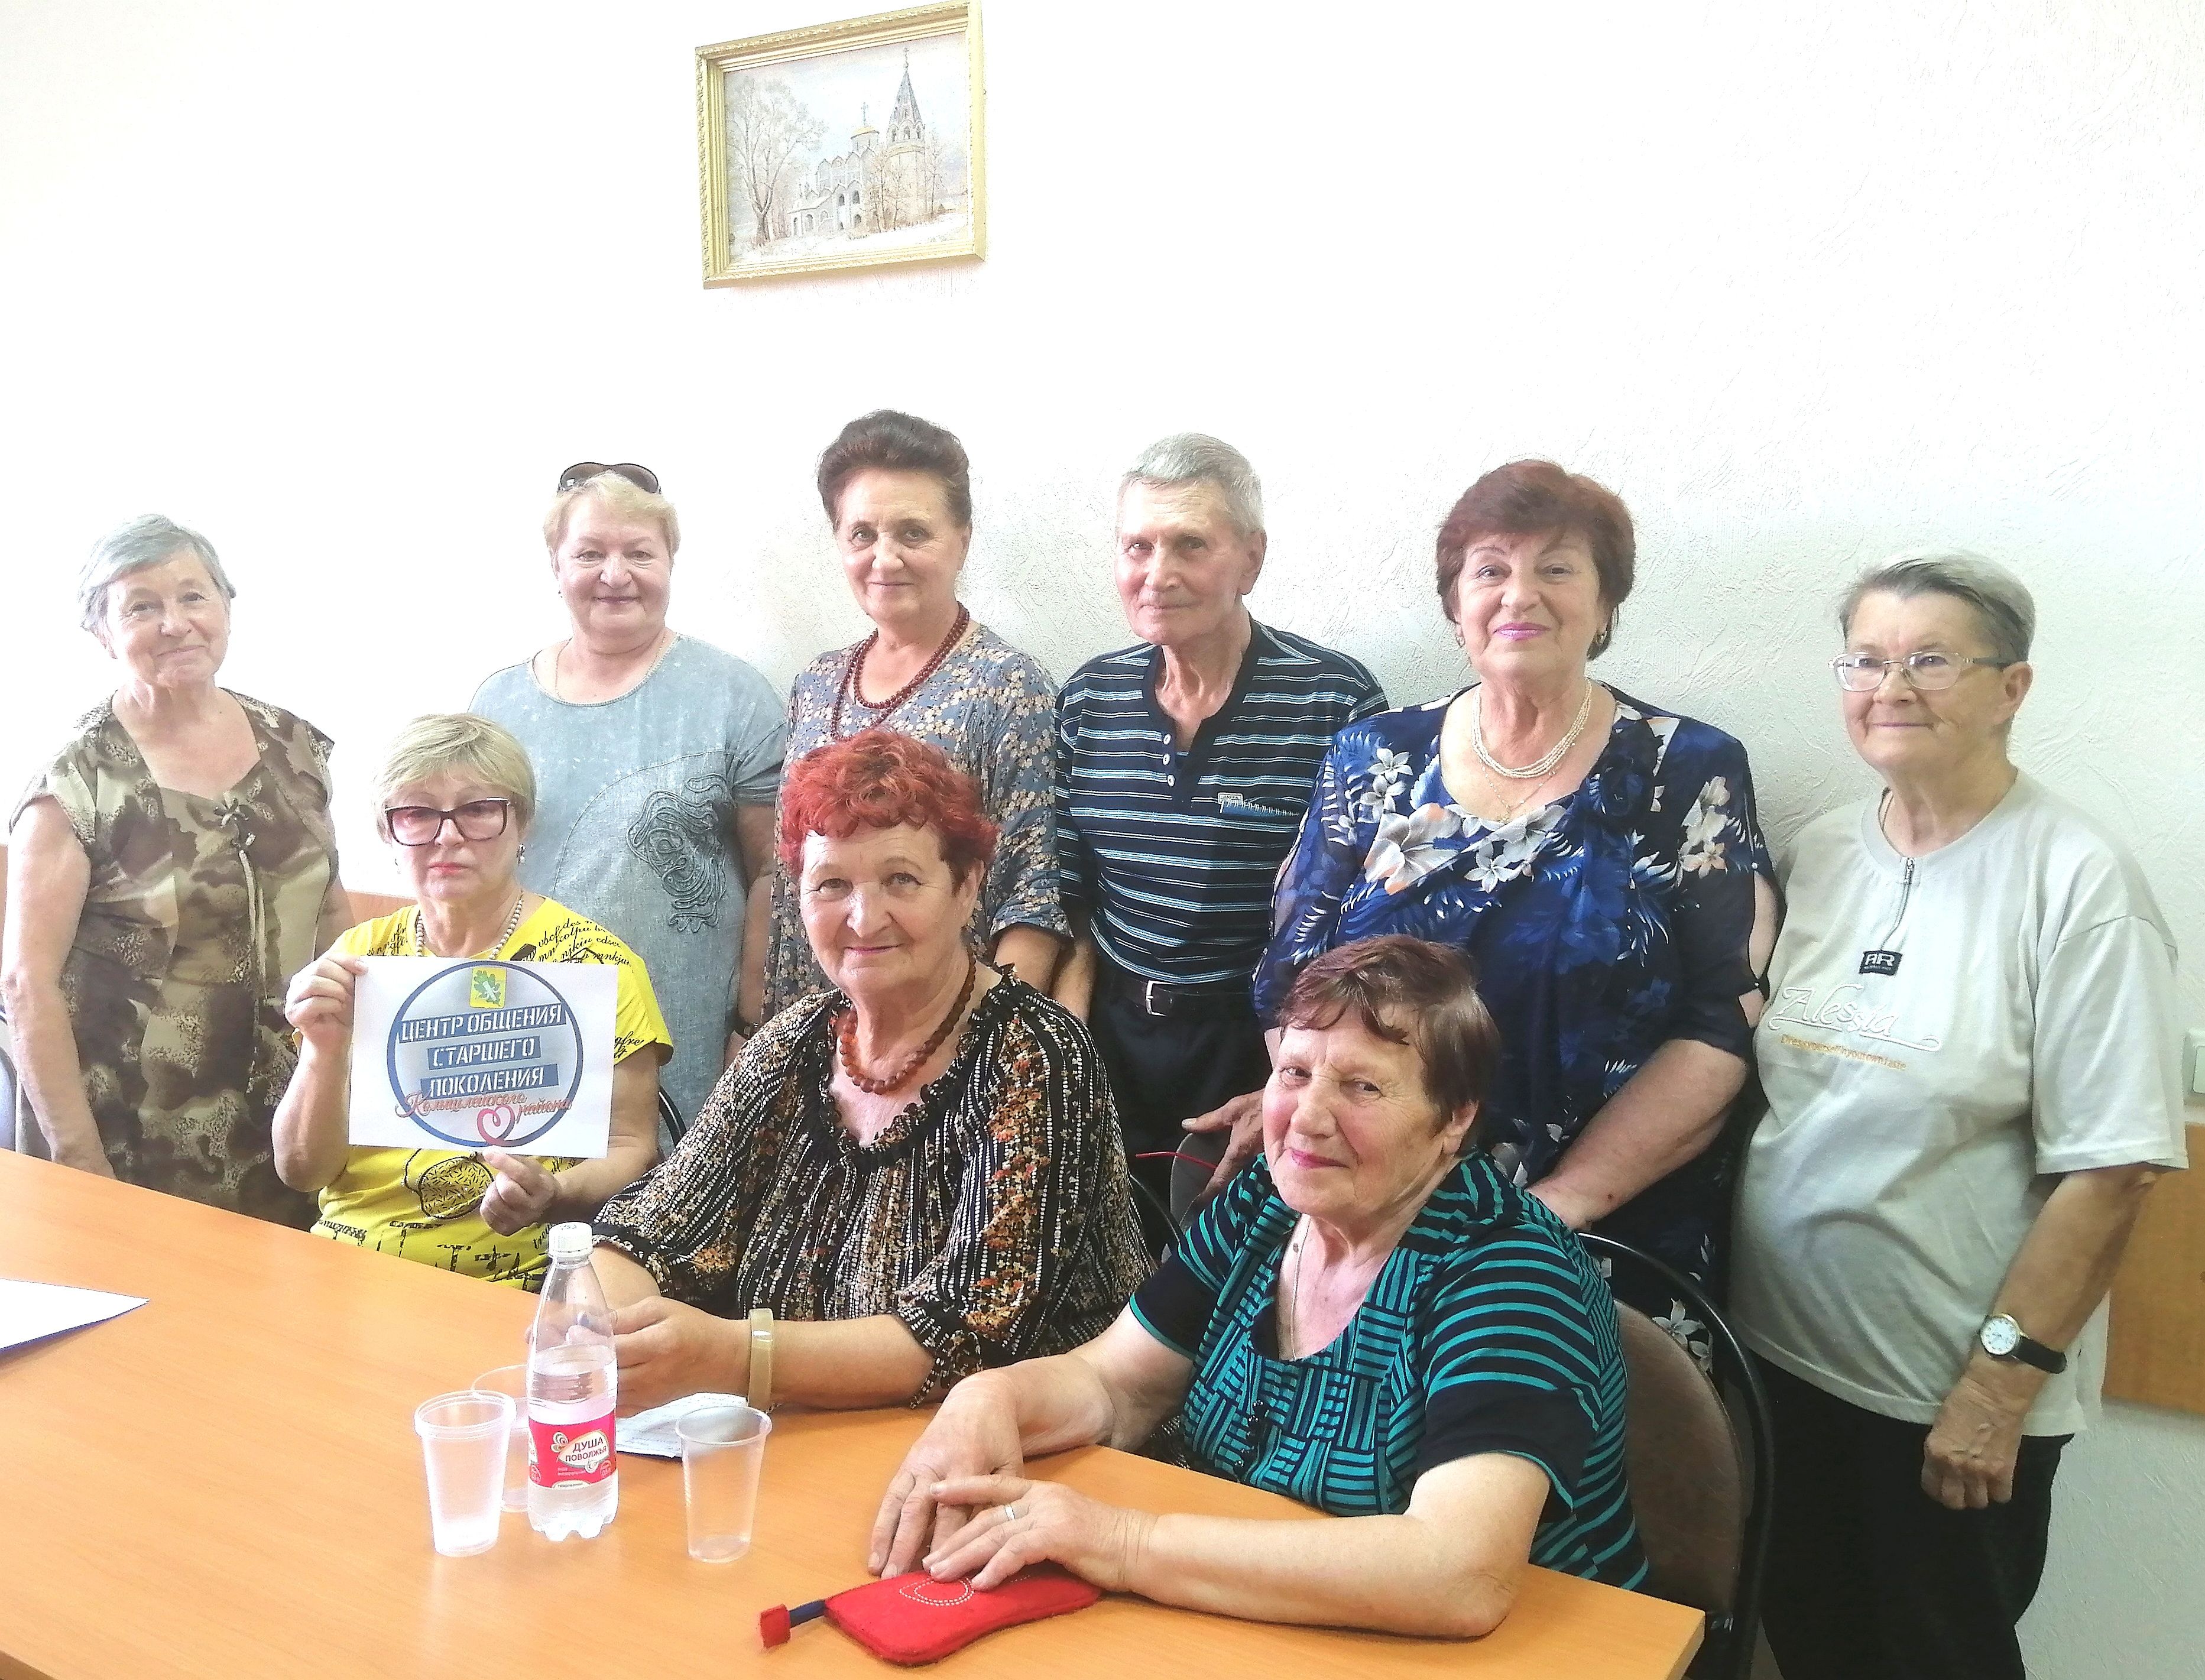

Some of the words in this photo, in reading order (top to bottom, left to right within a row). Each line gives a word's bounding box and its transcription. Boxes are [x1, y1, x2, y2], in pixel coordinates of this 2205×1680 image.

[401, 1016, 464, 1042] ЦЕНТР
[467, 1004, 562, 1034] ОБЩЕНИЯ
[433, 1037, 535, 1066] СТАРШЕГО
[430, 1066, 544, 1098] ПОКОЛЕНИЯ
[565, 1445, 607, 1462] ПОВОЛЖЬЯ
[572, 1436, 604, 1453] ДУША
